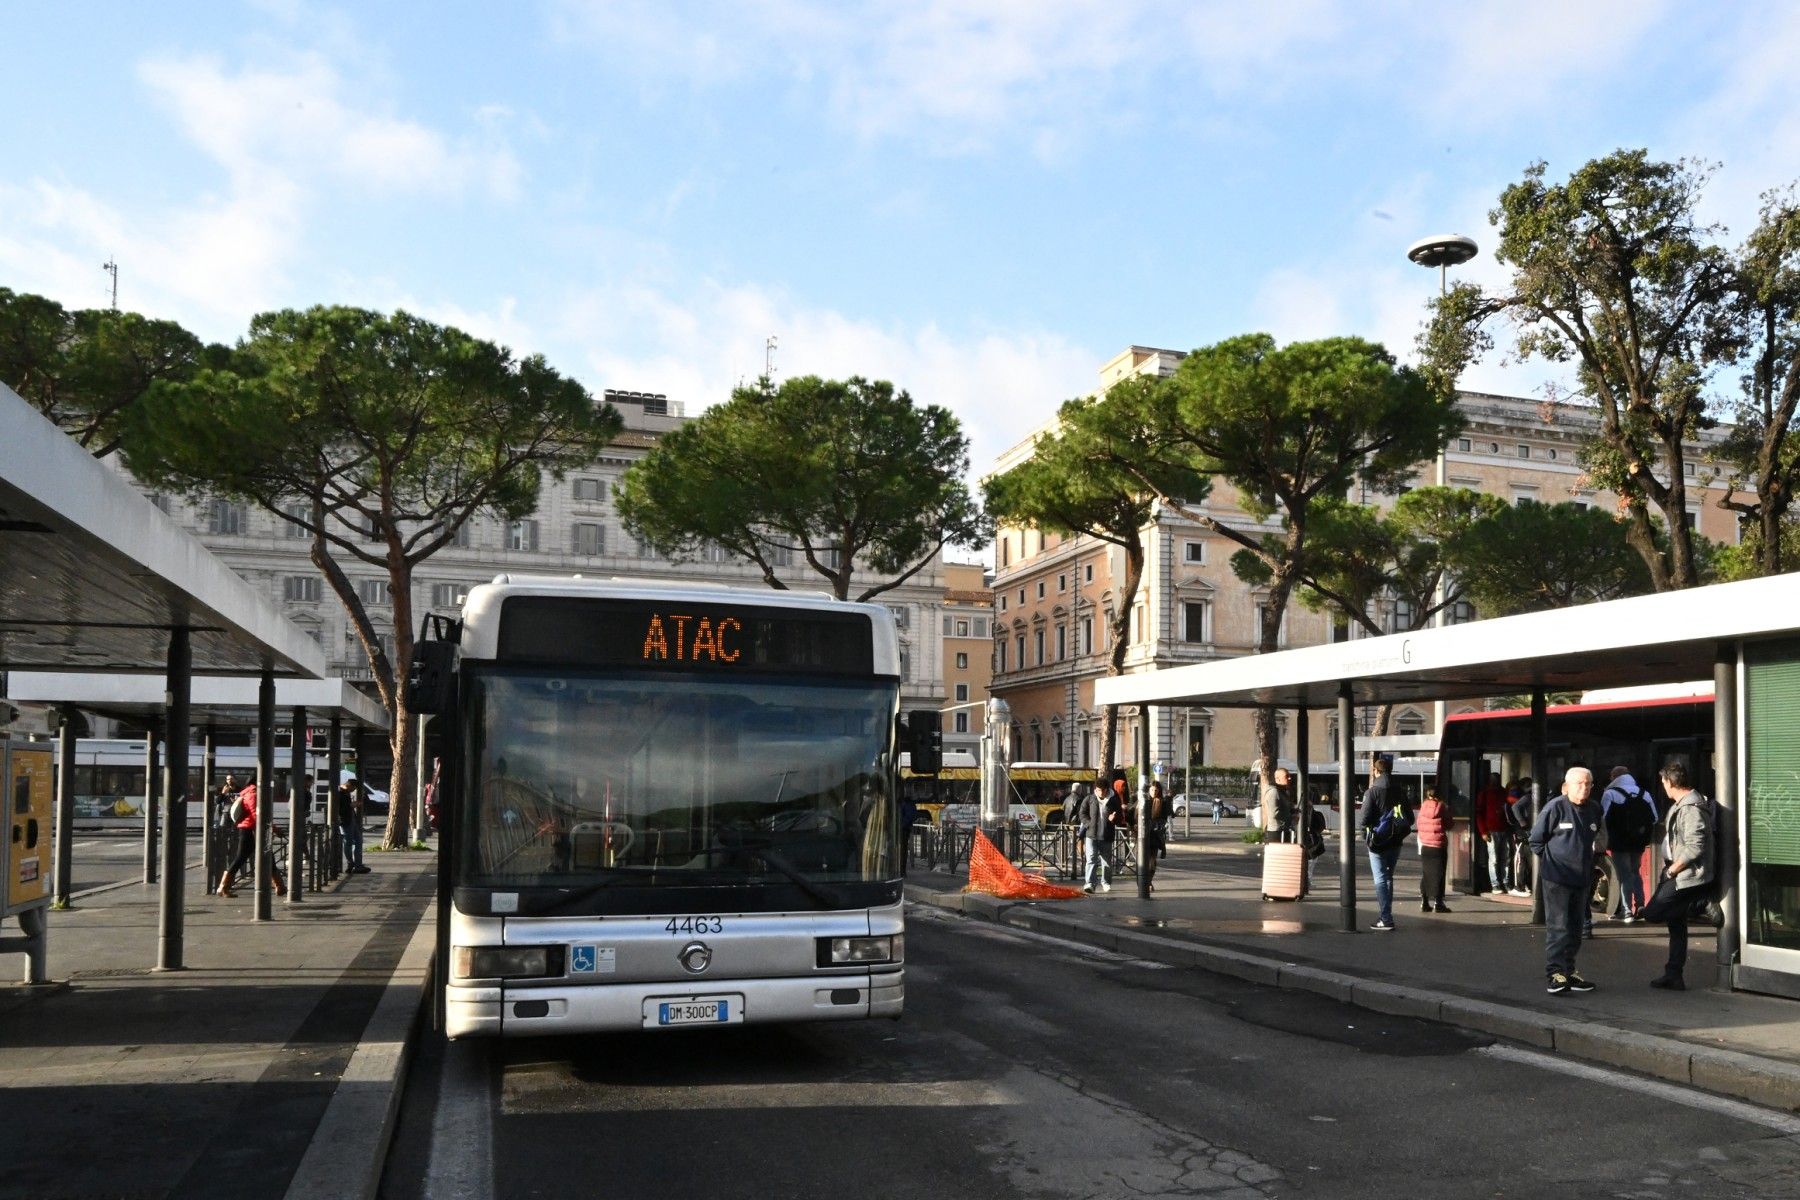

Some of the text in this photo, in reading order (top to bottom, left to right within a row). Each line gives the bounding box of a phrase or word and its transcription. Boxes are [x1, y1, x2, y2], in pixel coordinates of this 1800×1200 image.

[643, 613, 741, 662] ATAC
[1402, 639, 1411, 664] G
[665, 915, 723, 935] 4463
